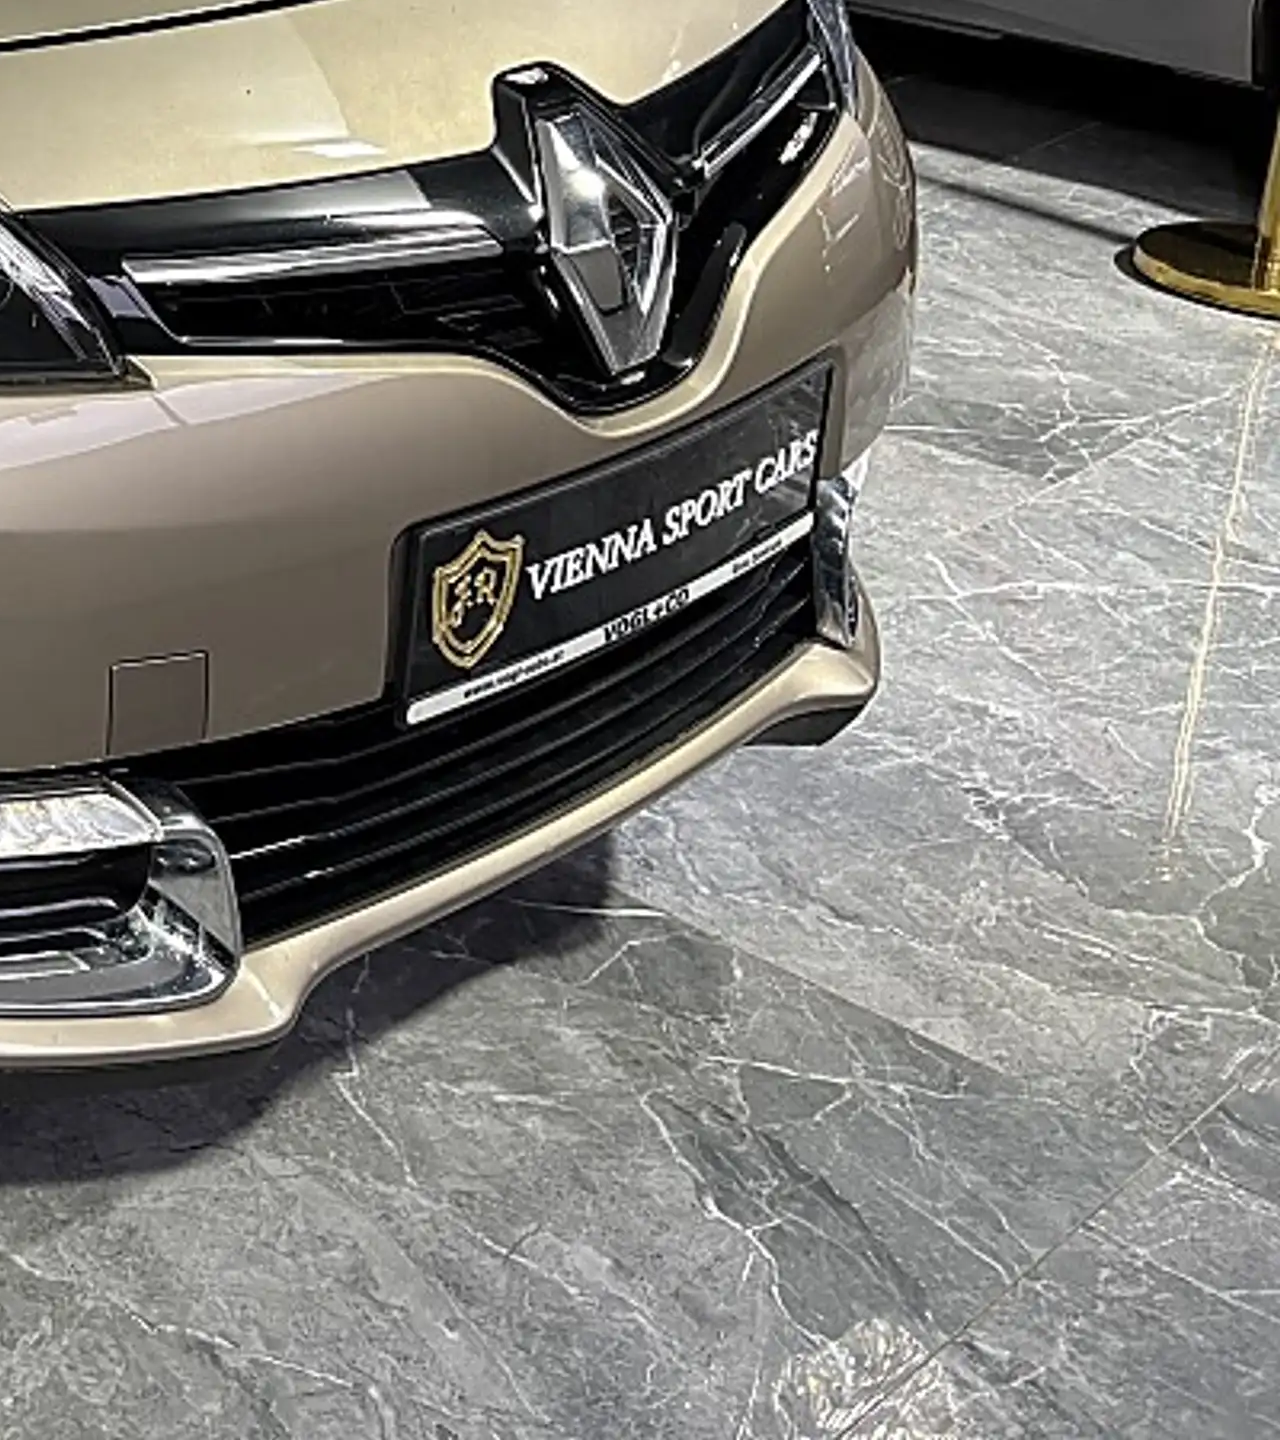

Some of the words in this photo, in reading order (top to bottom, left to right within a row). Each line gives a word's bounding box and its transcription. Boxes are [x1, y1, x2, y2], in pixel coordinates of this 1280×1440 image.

[525, 518, 657, 600] VIENNA
[662, 469, 753, 546] SPORT
[755, 430, 818, 494] CARS
